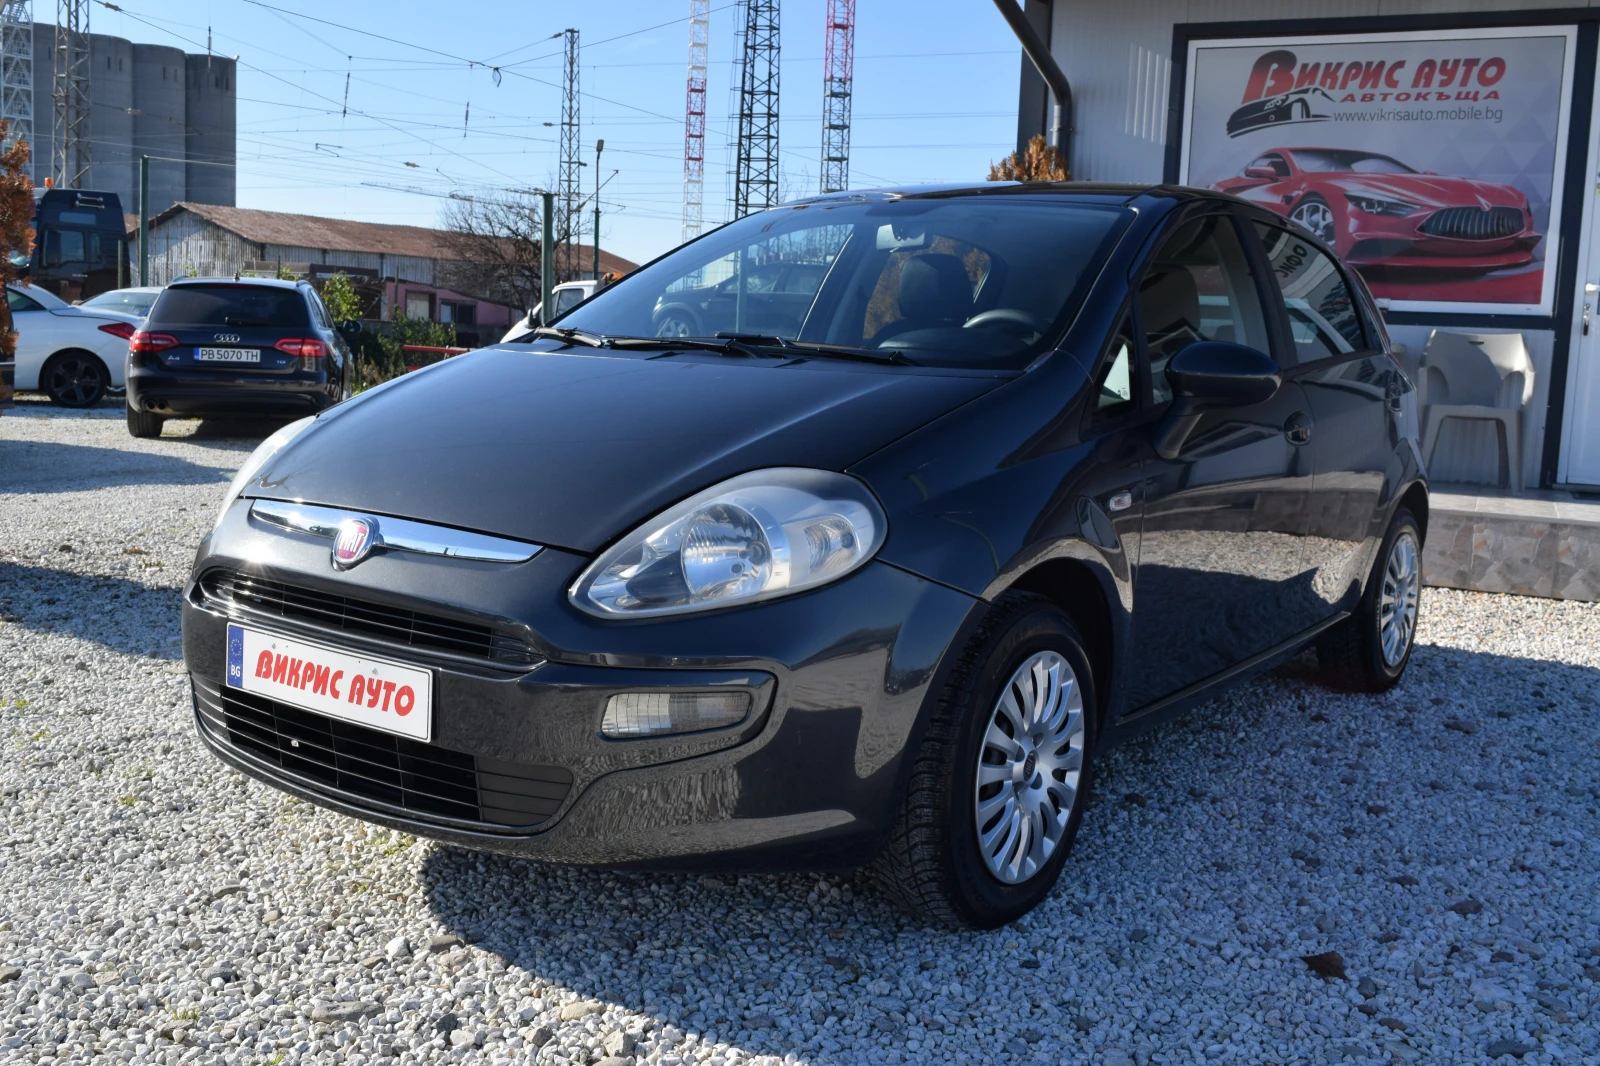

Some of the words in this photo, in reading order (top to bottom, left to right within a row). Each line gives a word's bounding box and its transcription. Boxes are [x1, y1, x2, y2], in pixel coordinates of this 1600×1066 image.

[1411, 57, 1507, 88] АУТО
[1339, 90, 1500, 103] АВТОКЪЩА
[1333, 105, 1503, 123] www.vikrisauto.mobile.bg
[216, 349, 242, 361] 5070
[230, 664, 241, 678] BG
[255, 650, 344, 699] ВИКРИС
[348, 674, 415, 716] АУТО
